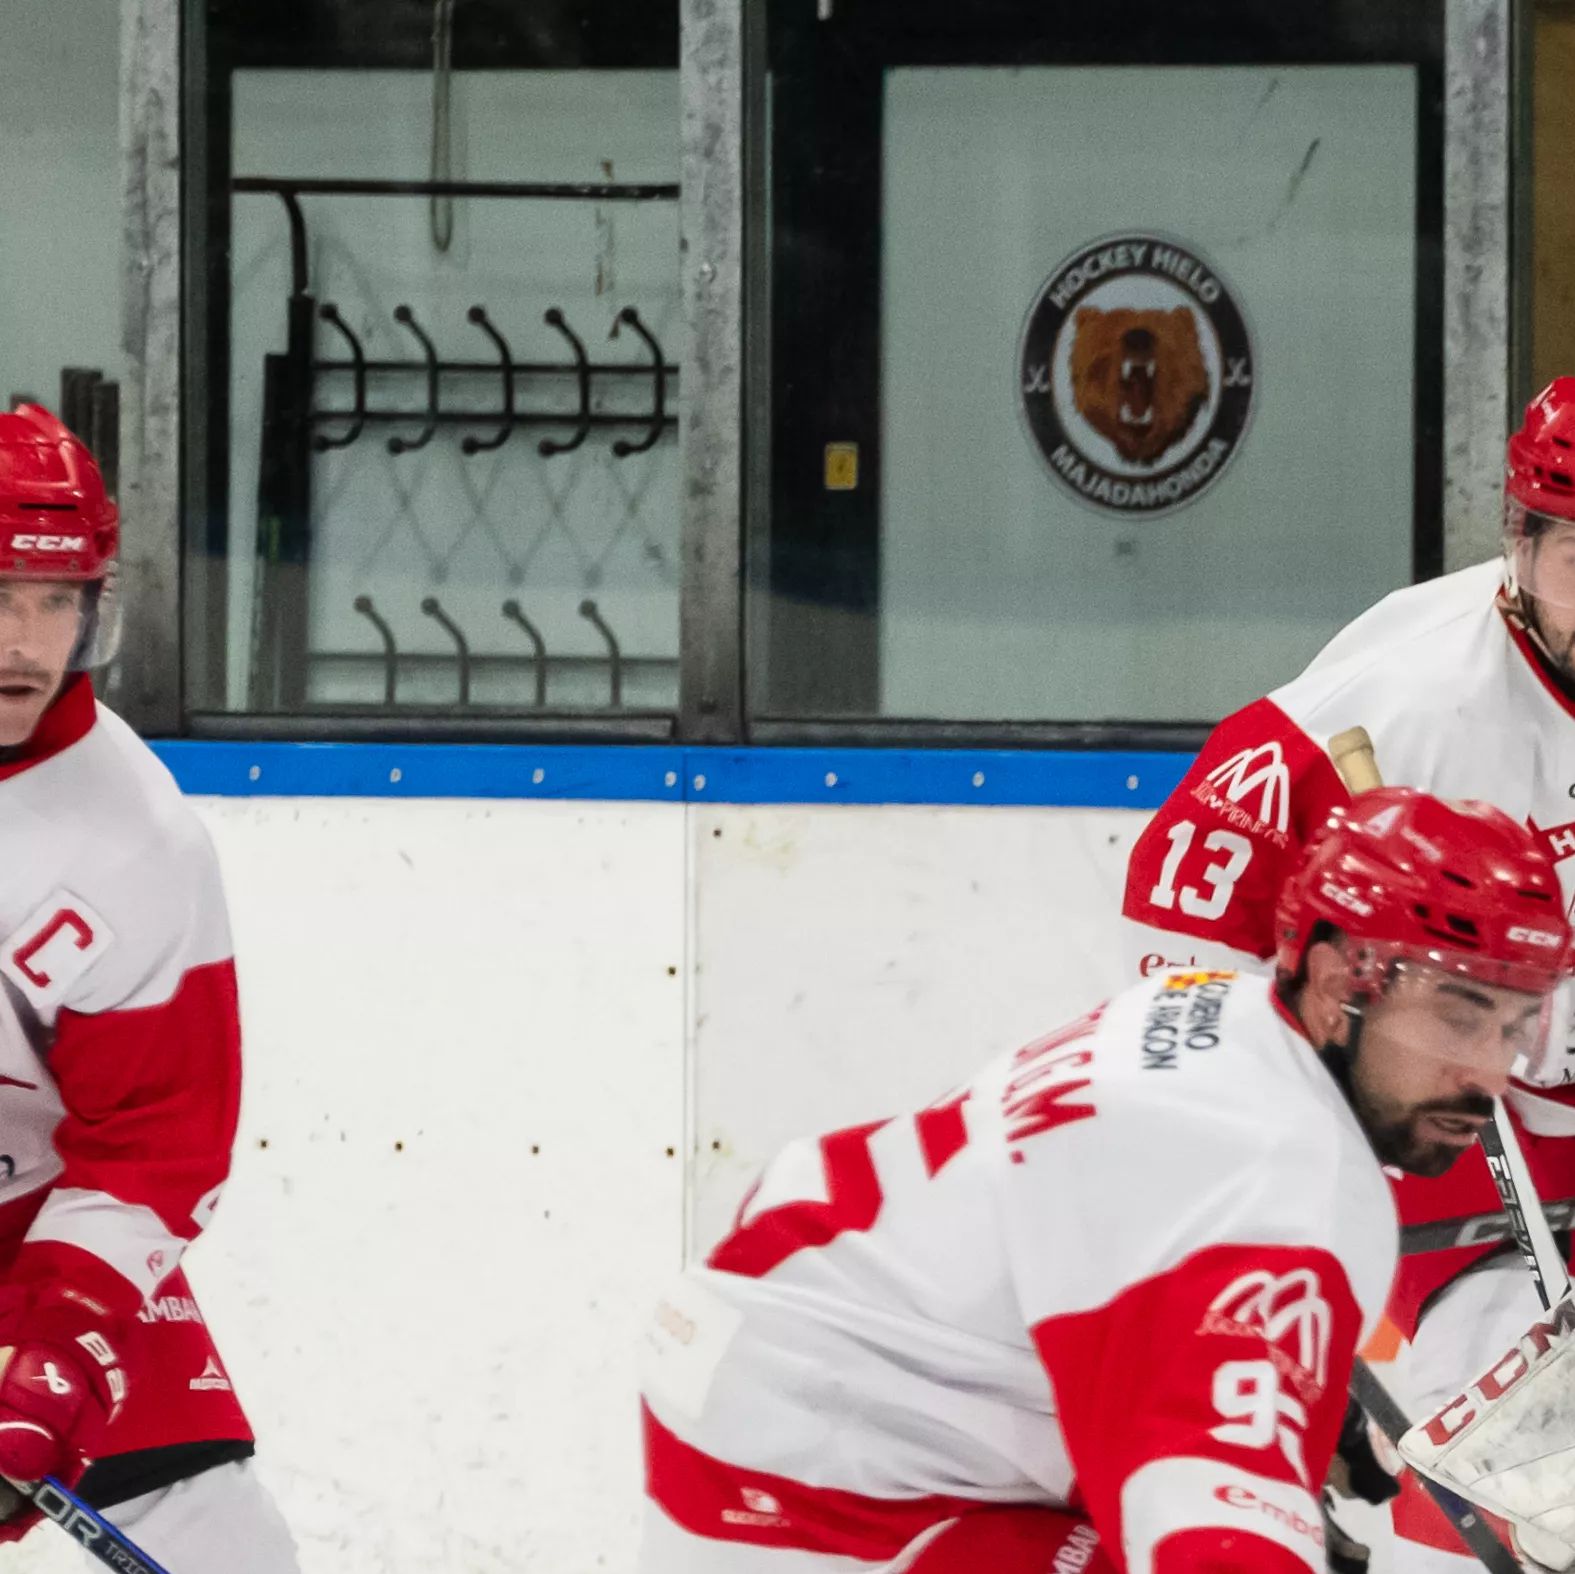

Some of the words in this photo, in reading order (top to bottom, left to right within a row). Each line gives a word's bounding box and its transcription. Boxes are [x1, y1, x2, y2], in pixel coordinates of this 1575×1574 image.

[1050, 245, 1148, 308] HOCKEY
[1151, 246, 1221, 304] HIELO
[1052, 438, 1228, 505] MAJADAHONDA
[10, 533, 86, 552] CCM
[1149, 820, 1253, 921] 13
[12, 908, 94, 988] C
